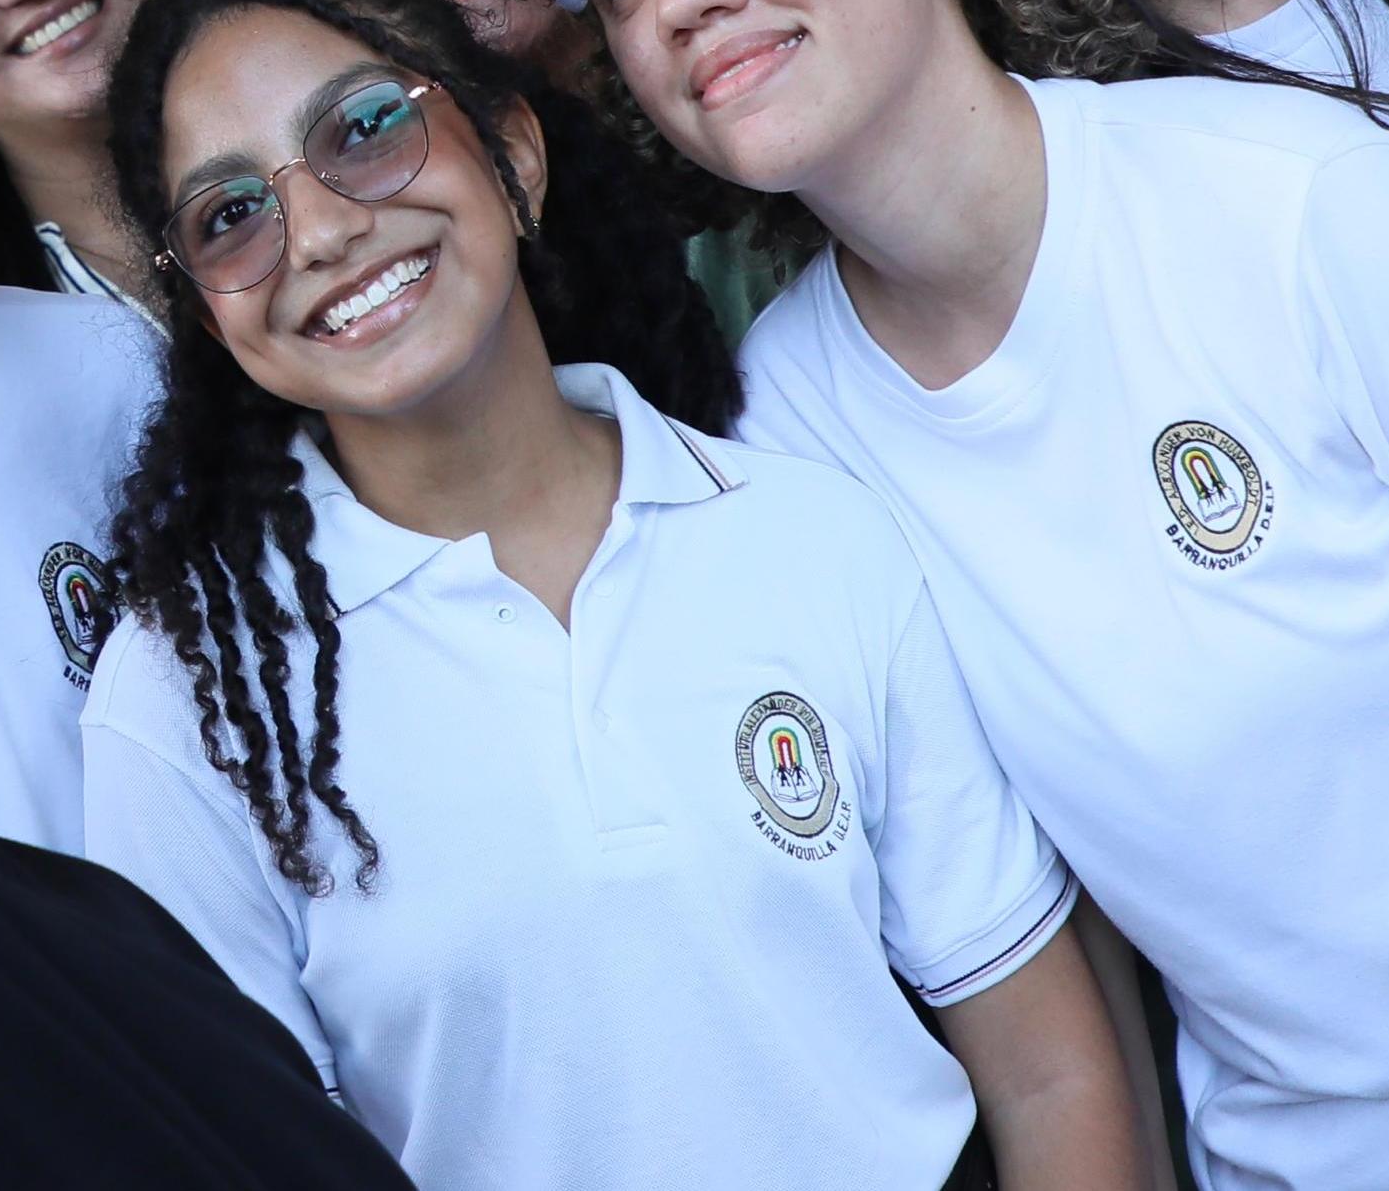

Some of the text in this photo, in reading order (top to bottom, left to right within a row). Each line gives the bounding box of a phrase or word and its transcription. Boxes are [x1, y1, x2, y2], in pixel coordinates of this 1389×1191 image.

[1158, 431, 1183, 500] ALEXANDER
[1186, 426, 1216, 439] VON
[1218, 437, 1260, 507] HUMBOLDT
[1165, 524, 1264, 570] BARRANQUILLA
[750, 811, 838, 861] BARRANQUILLA
